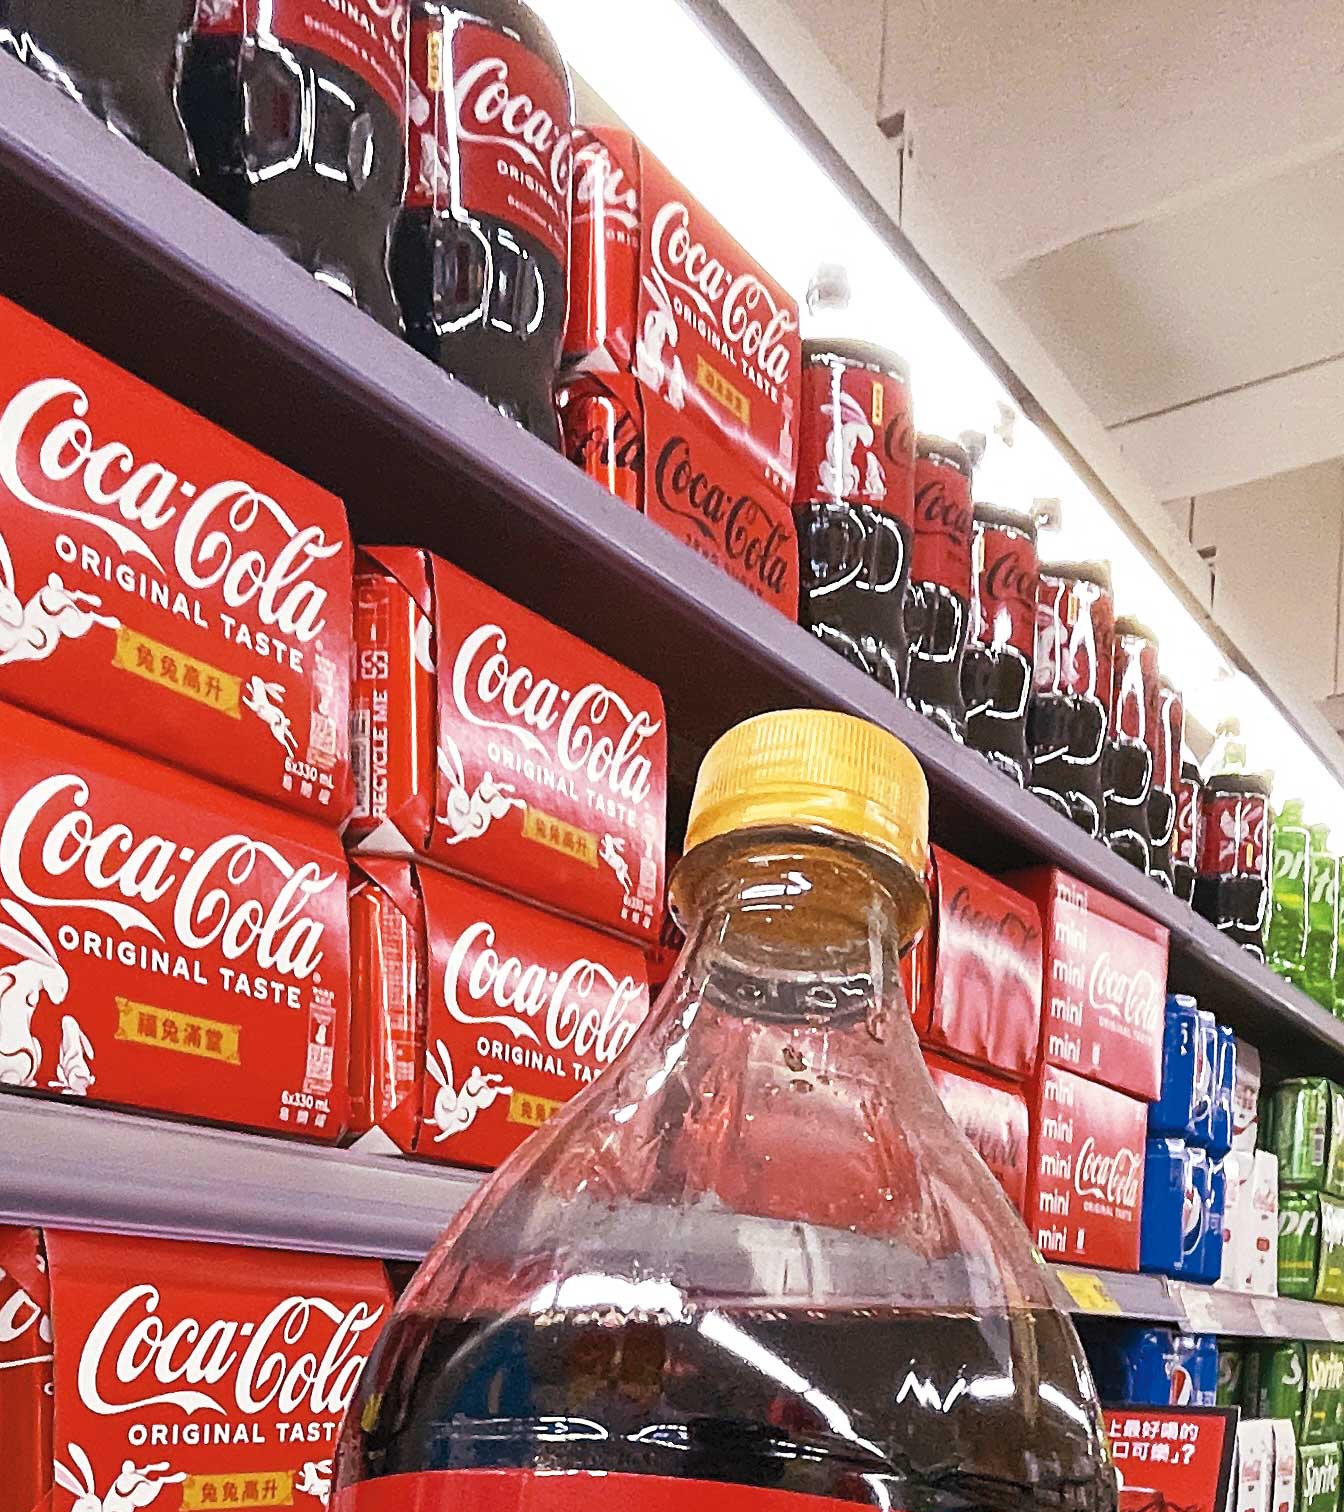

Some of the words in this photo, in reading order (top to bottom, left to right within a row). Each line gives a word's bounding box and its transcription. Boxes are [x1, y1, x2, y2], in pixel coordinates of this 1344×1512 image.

[652, 201, 796, 386] Coca-Cola
[674, 299, 737, 366] ORIGINAL
[656, 434, 792, 594] Coca-Cola
[55, 532, 207, 629] ORIGINAL
[219, 610, 306, 674] TASTE
[453, 624, 661, 803] Coca-Cola
[487, 742, 580, 803] ORIGINAL
[585, 787, 638, 828] TASTE
[1055, 919, 1088, 954] mini
[58, 924, 207, 986] ORIGINAL
[218, 970, 303, 1010] TASTE
[1053, 958, 1086, 991] mini
[1051, 997, 1083, 1028] mini
[476, 1035, 567, 1078] ORIGINAL
[1049, 1034, 1081, 1064] mini
[1042, 1115, 1073, 1144] mini
[1041, 1151, 1071, 1180] mini
[1074, 1136, 1140, 1208] Coca-Cola
[1039, 1189, 1070, 1217] mini
[1038, 1226, 1067, 1253] mini
[77, 1284, 384, 1415] Coca-Cola
[128, 1423, 266, 1446] ORIGINAL
